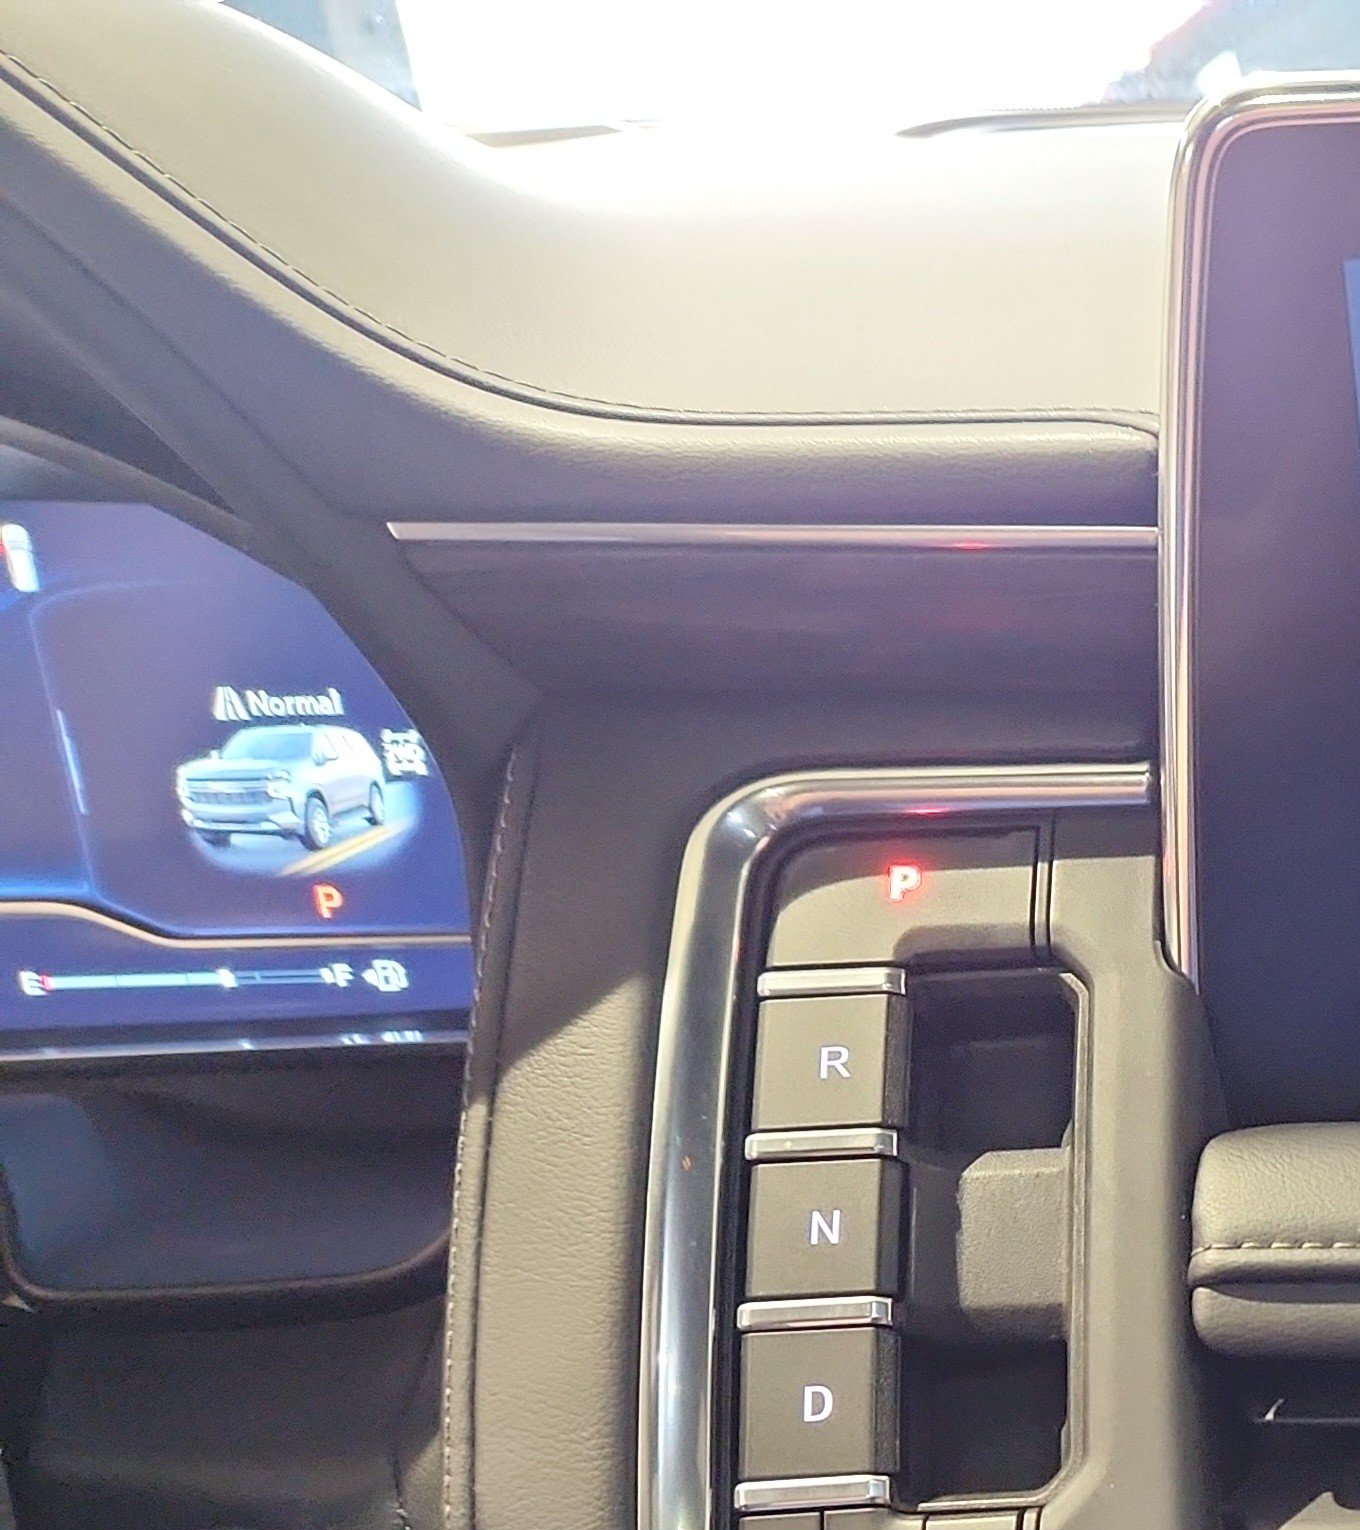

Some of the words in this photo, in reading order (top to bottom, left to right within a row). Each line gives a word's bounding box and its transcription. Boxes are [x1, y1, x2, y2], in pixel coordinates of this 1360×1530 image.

[247, 688, 345, 717] Normal
[888, 864, 922, 901] P
[312, 883, 344, 919] P
[819, 1045, 852, 1080] R
[810, 1209, 842, 1245] N
[802, 1385, 834, 1422] D
